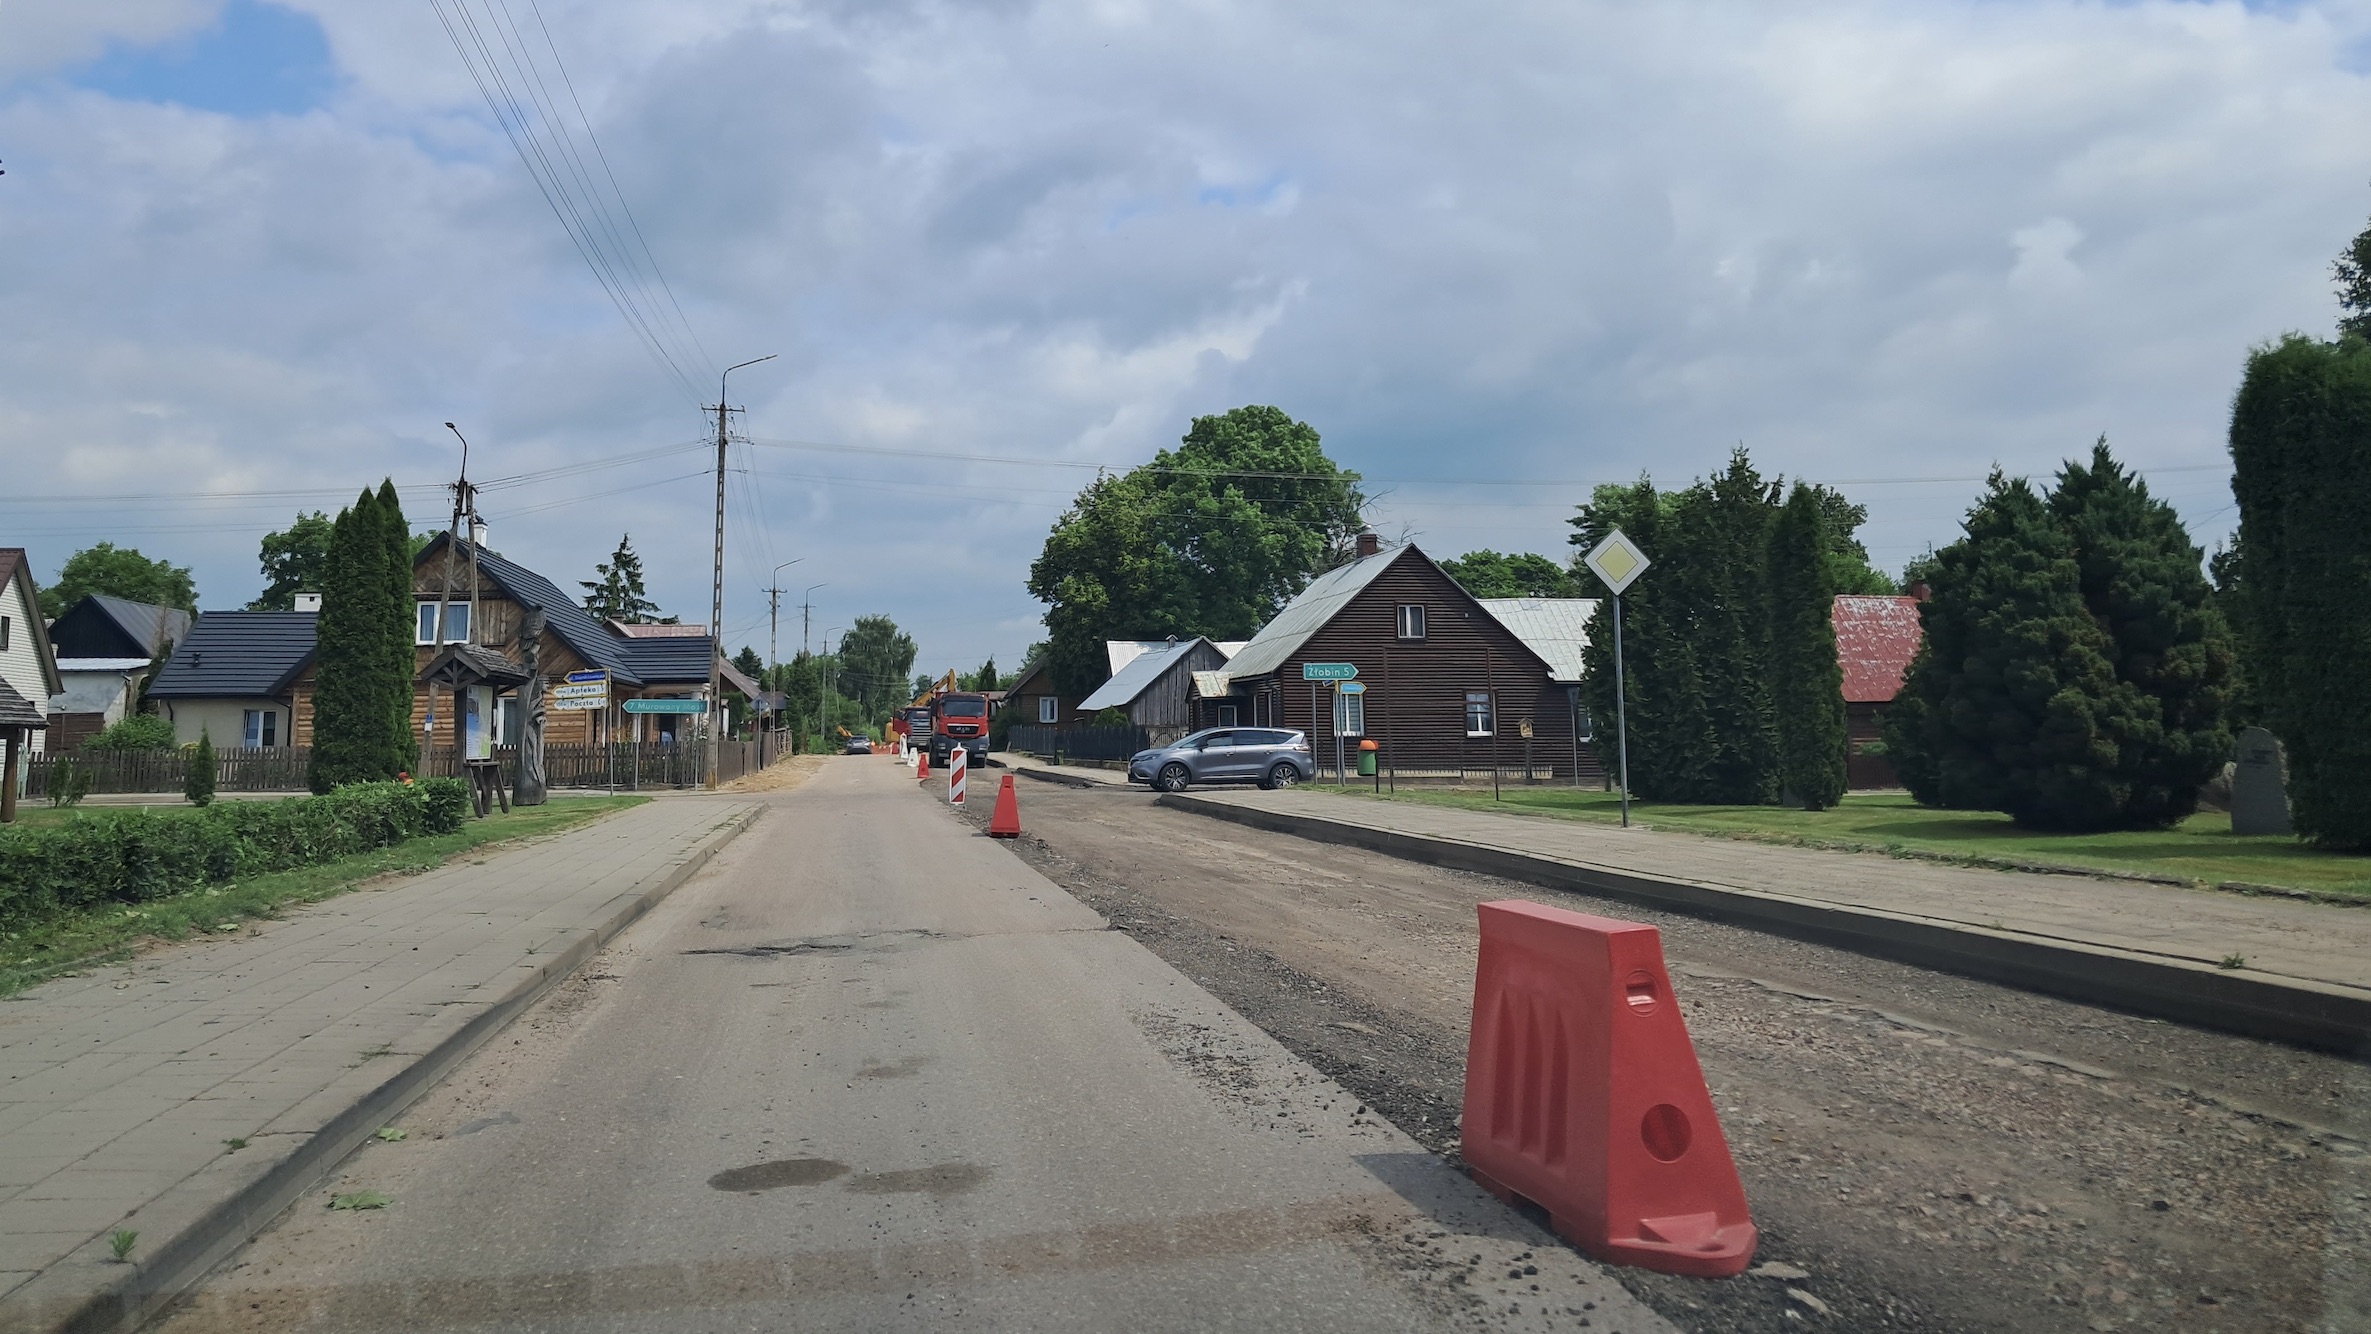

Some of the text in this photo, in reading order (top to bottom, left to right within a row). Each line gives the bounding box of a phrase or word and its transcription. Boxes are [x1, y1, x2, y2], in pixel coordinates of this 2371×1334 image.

[1308, 664, 1350, 677] Żłobin 5
[570, 686, 597, 695] Apteka
[629, 702, 635, 710] 7
[637, 702, 680, 712] Murowany
